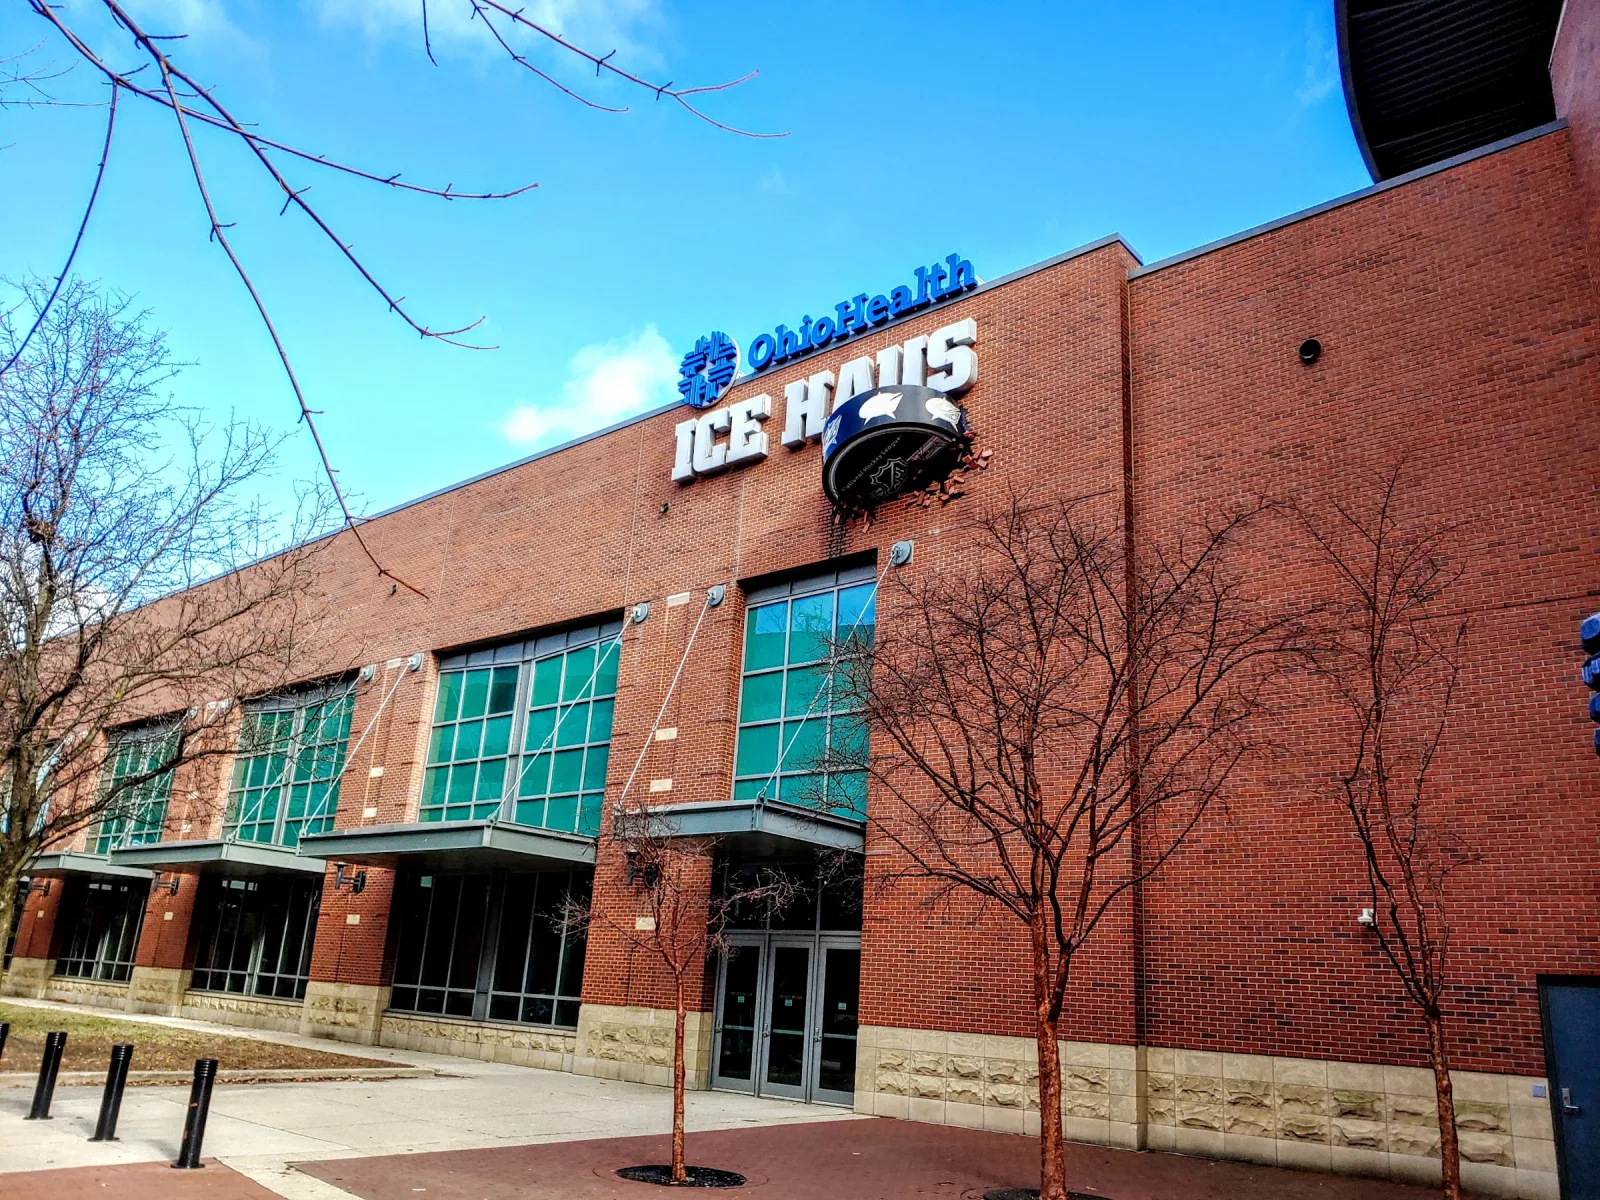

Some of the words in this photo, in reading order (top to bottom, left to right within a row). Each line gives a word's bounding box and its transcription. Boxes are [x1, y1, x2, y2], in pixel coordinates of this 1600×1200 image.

[748, 253, 978, 372] OhioHealth
[671, 393, 772, 485] ICE
[862, 453, 884, 473] Hockey
[881, 435, 902, 457] League
